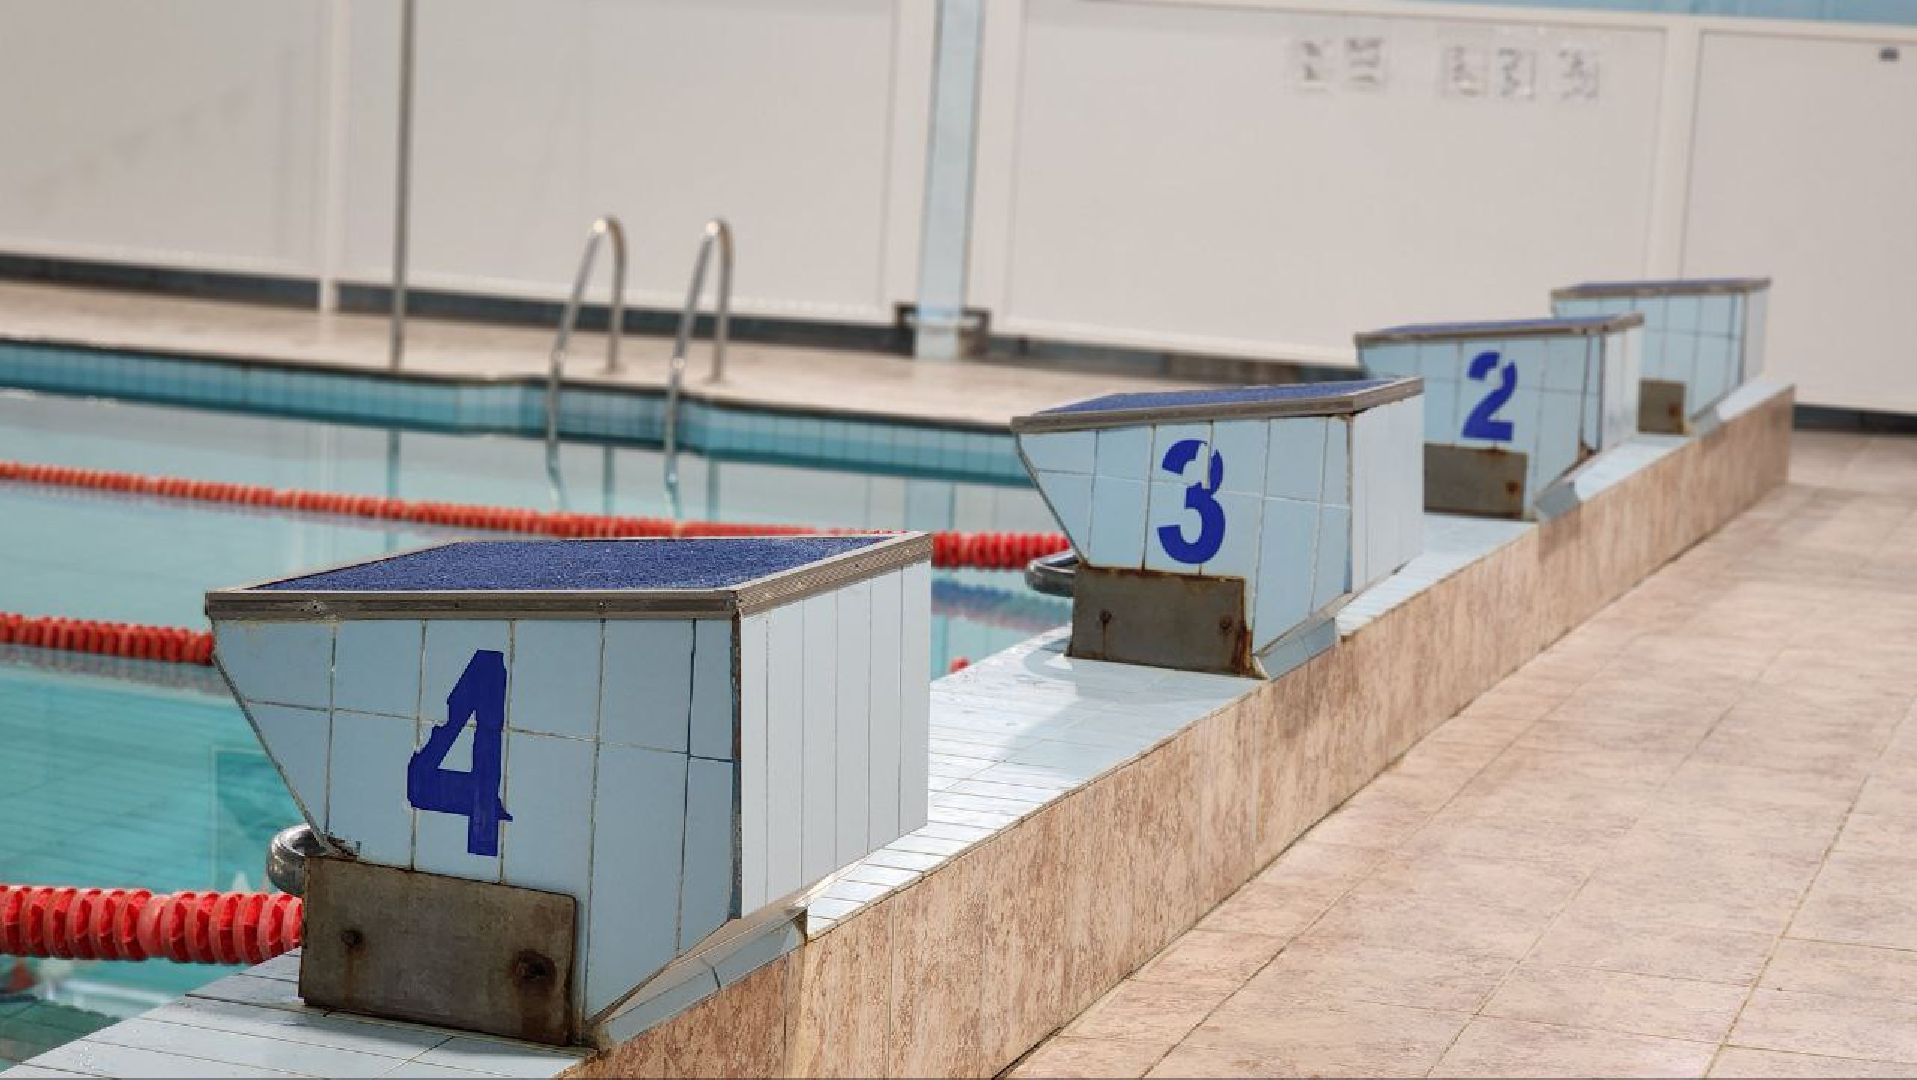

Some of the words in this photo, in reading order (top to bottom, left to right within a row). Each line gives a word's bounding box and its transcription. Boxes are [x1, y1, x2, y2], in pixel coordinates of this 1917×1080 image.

[1462, 351, 1518, 441] 2
[1157, 439, 1226, 564] 3
[407, 650, 513, 856] 4
